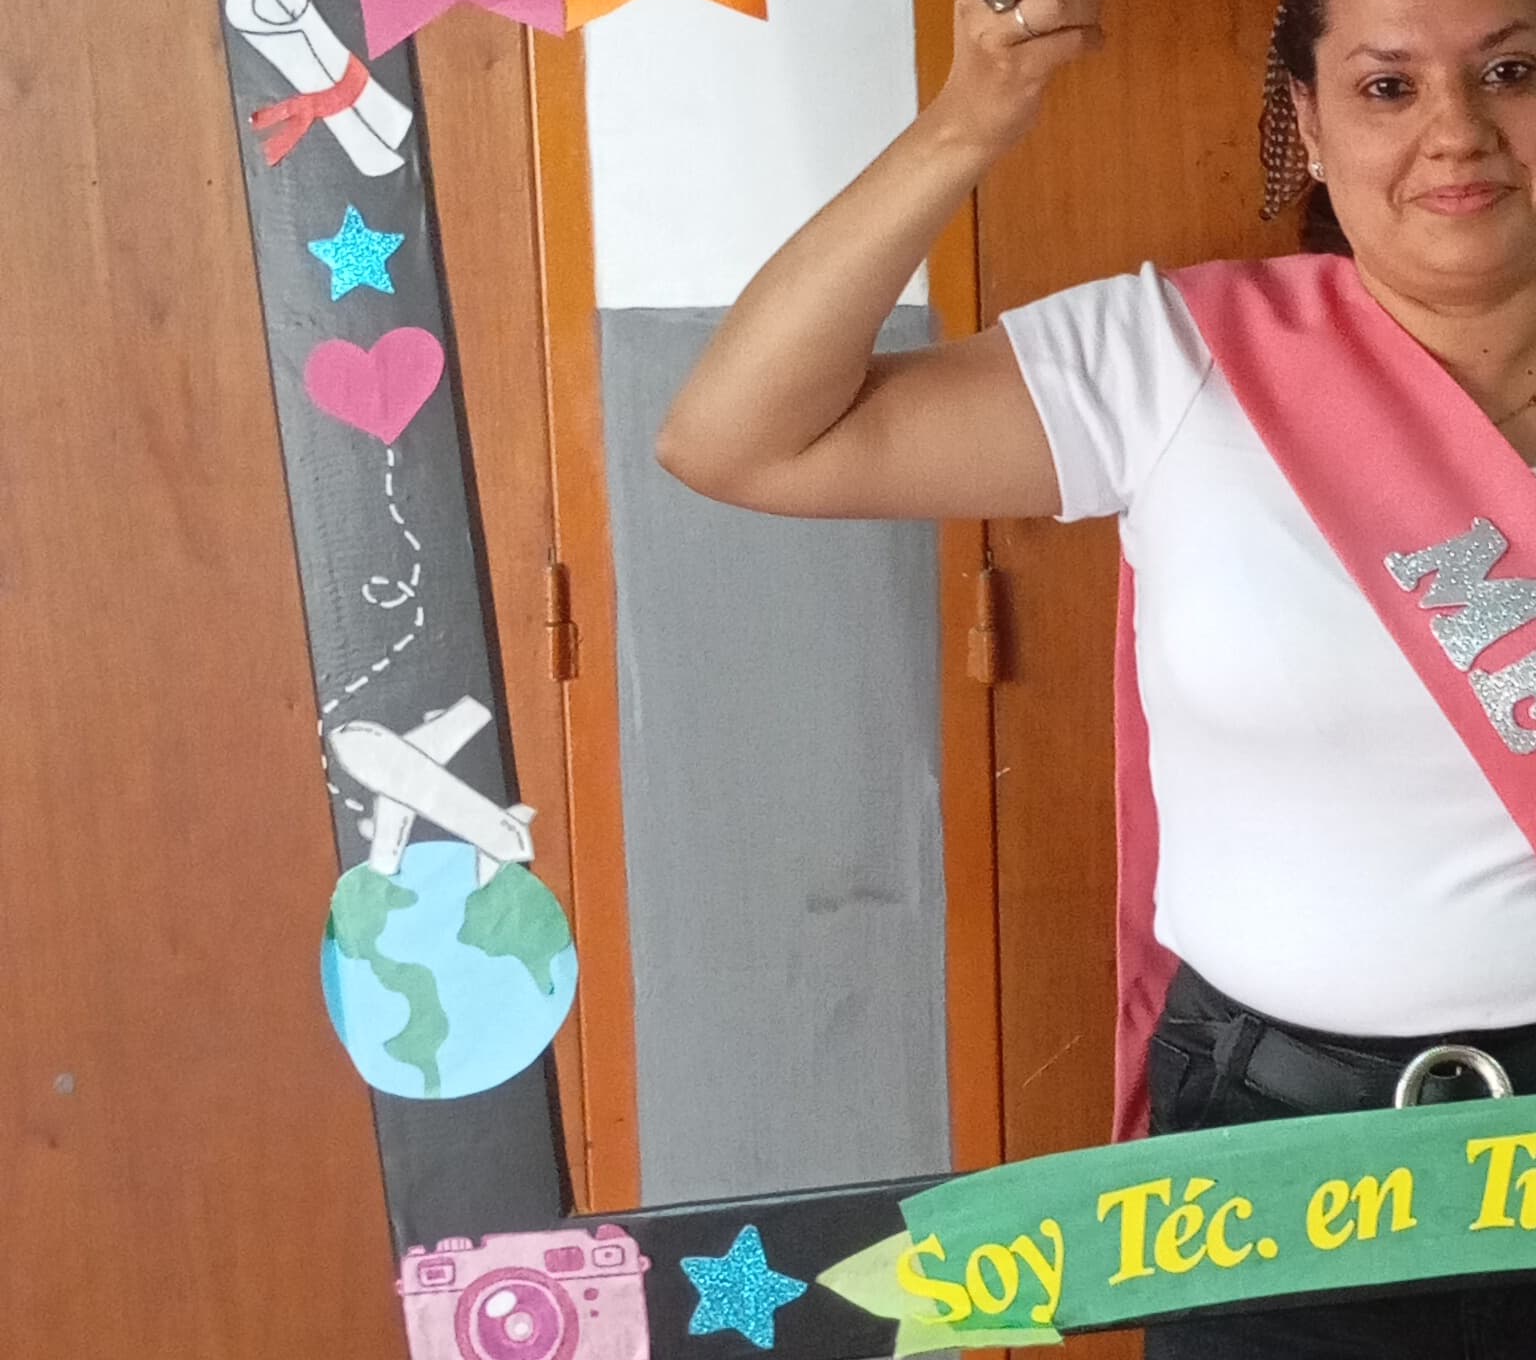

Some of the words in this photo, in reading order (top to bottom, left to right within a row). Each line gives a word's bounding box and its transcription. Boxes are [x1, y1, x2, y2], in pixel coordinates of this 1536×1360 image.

[896, 1219, 1065, 1328] Soy
[1096, 1174, 1278, 1287] Téc.
[1306, 1163, 1416, 1249] en
